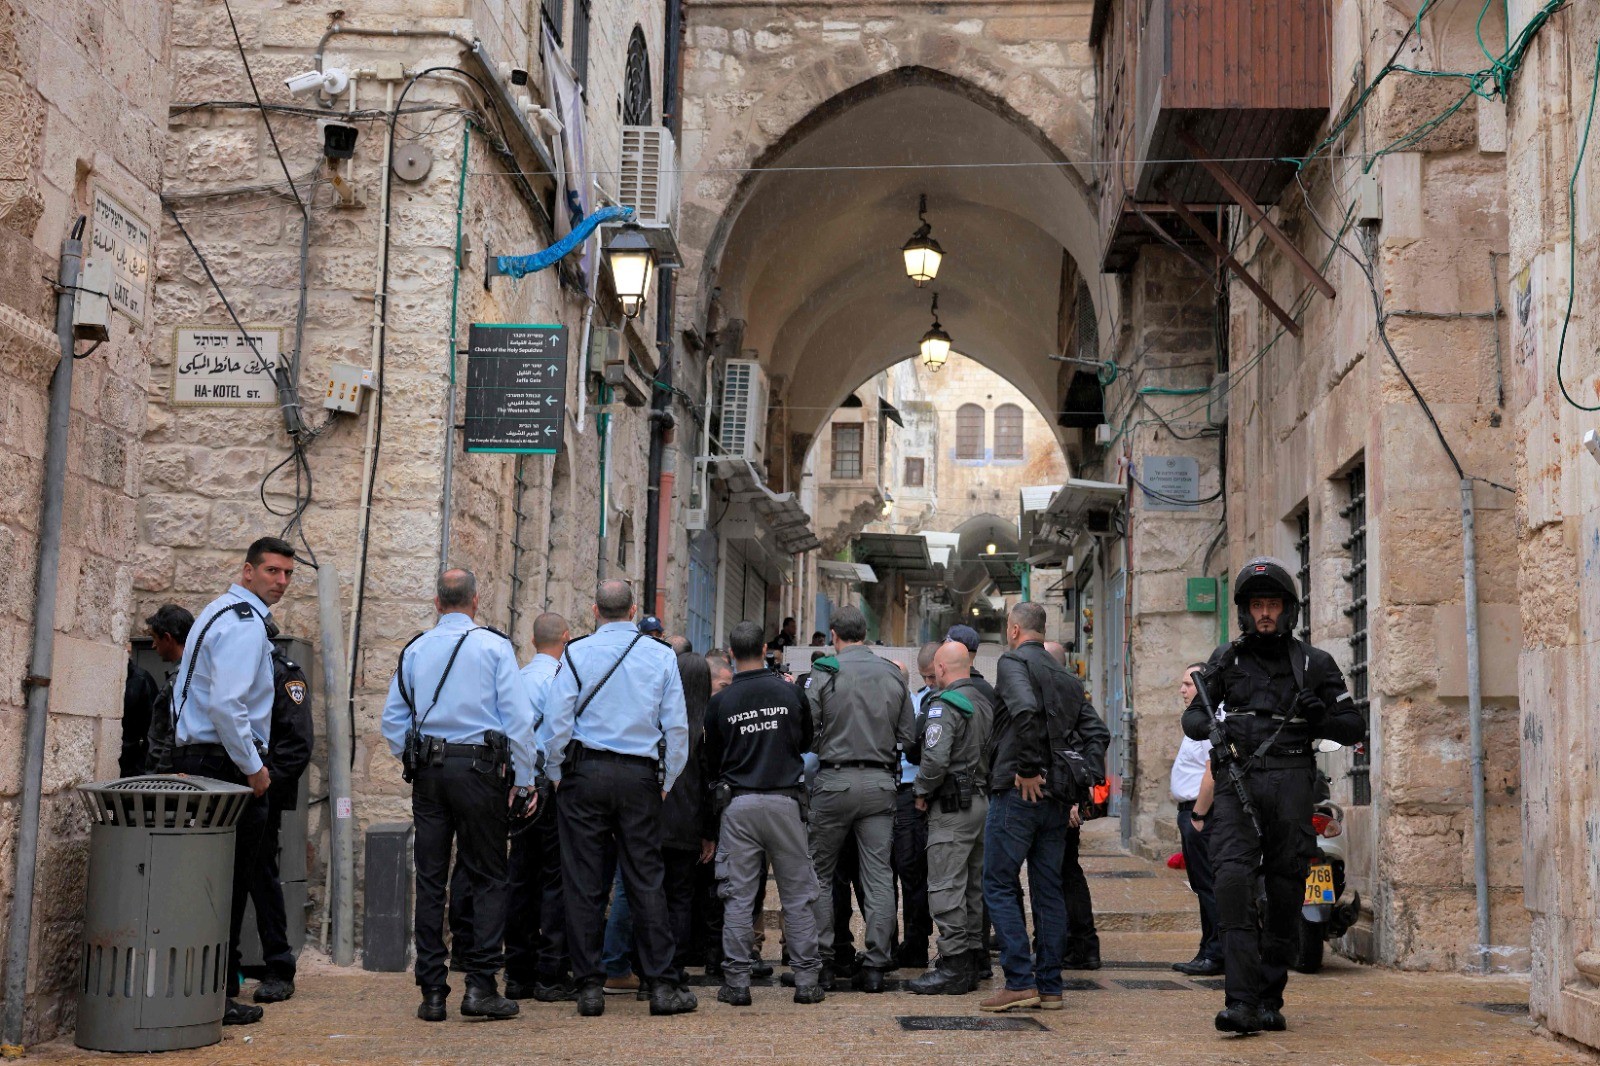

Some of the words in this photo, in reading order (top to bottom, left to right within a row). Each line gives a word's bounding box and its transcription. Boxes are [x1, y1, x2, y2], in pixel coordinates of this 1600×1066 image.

[116, 248, 128, 271] باب
[128, 257, 146, 277] طريق
[114, 282, 129, 307] GATE
[130, 301, 139, 314] ST.
[193, 333, 229, 349] הכותל
[236, 335, 263, 349] רחוב
[208, 355, 241, 375] حائط
[243, 358, 275, 375] طريق
[194, 384, 241, 398] HA-KOTEL
[246, 390, 261, 399] ST.
[727, 709, 759, 725] מבצעי
[759, 706, 789, 717] תיעוד
[739, 720, 779, 735] POLICE
[1310, 869, 1331, 883] 768
